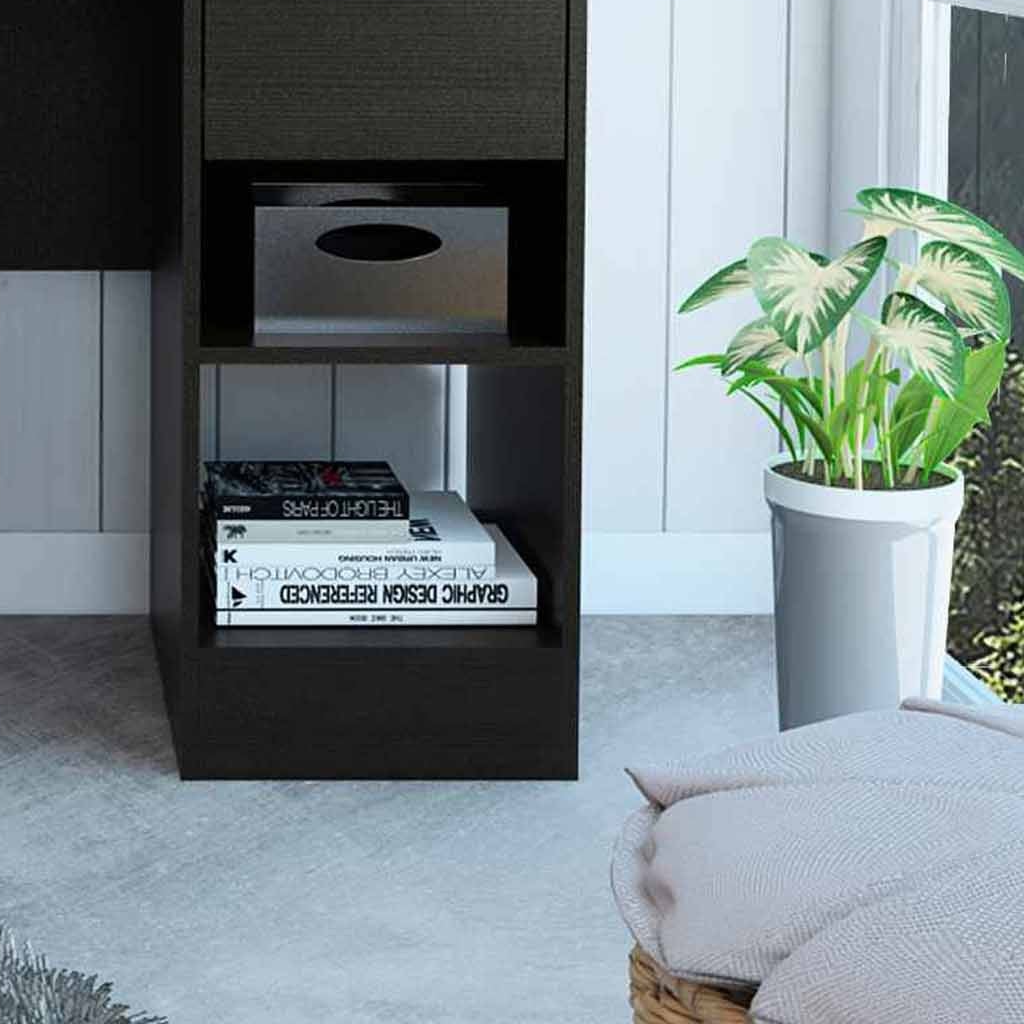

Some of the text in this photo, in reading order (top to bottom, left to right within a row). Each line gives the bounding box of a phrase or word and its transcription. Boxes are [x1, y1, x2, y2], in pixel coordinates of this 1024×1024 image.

[419, 554, 442, 563] NEW
[235, 566, 487, 582] ALEXEY BRODOVITCH
[279, 583, 377, 604] REFERENCED
[383, 583, 437, 604] DESIGN
[442, 583, 509, 604] GRAPHIC
